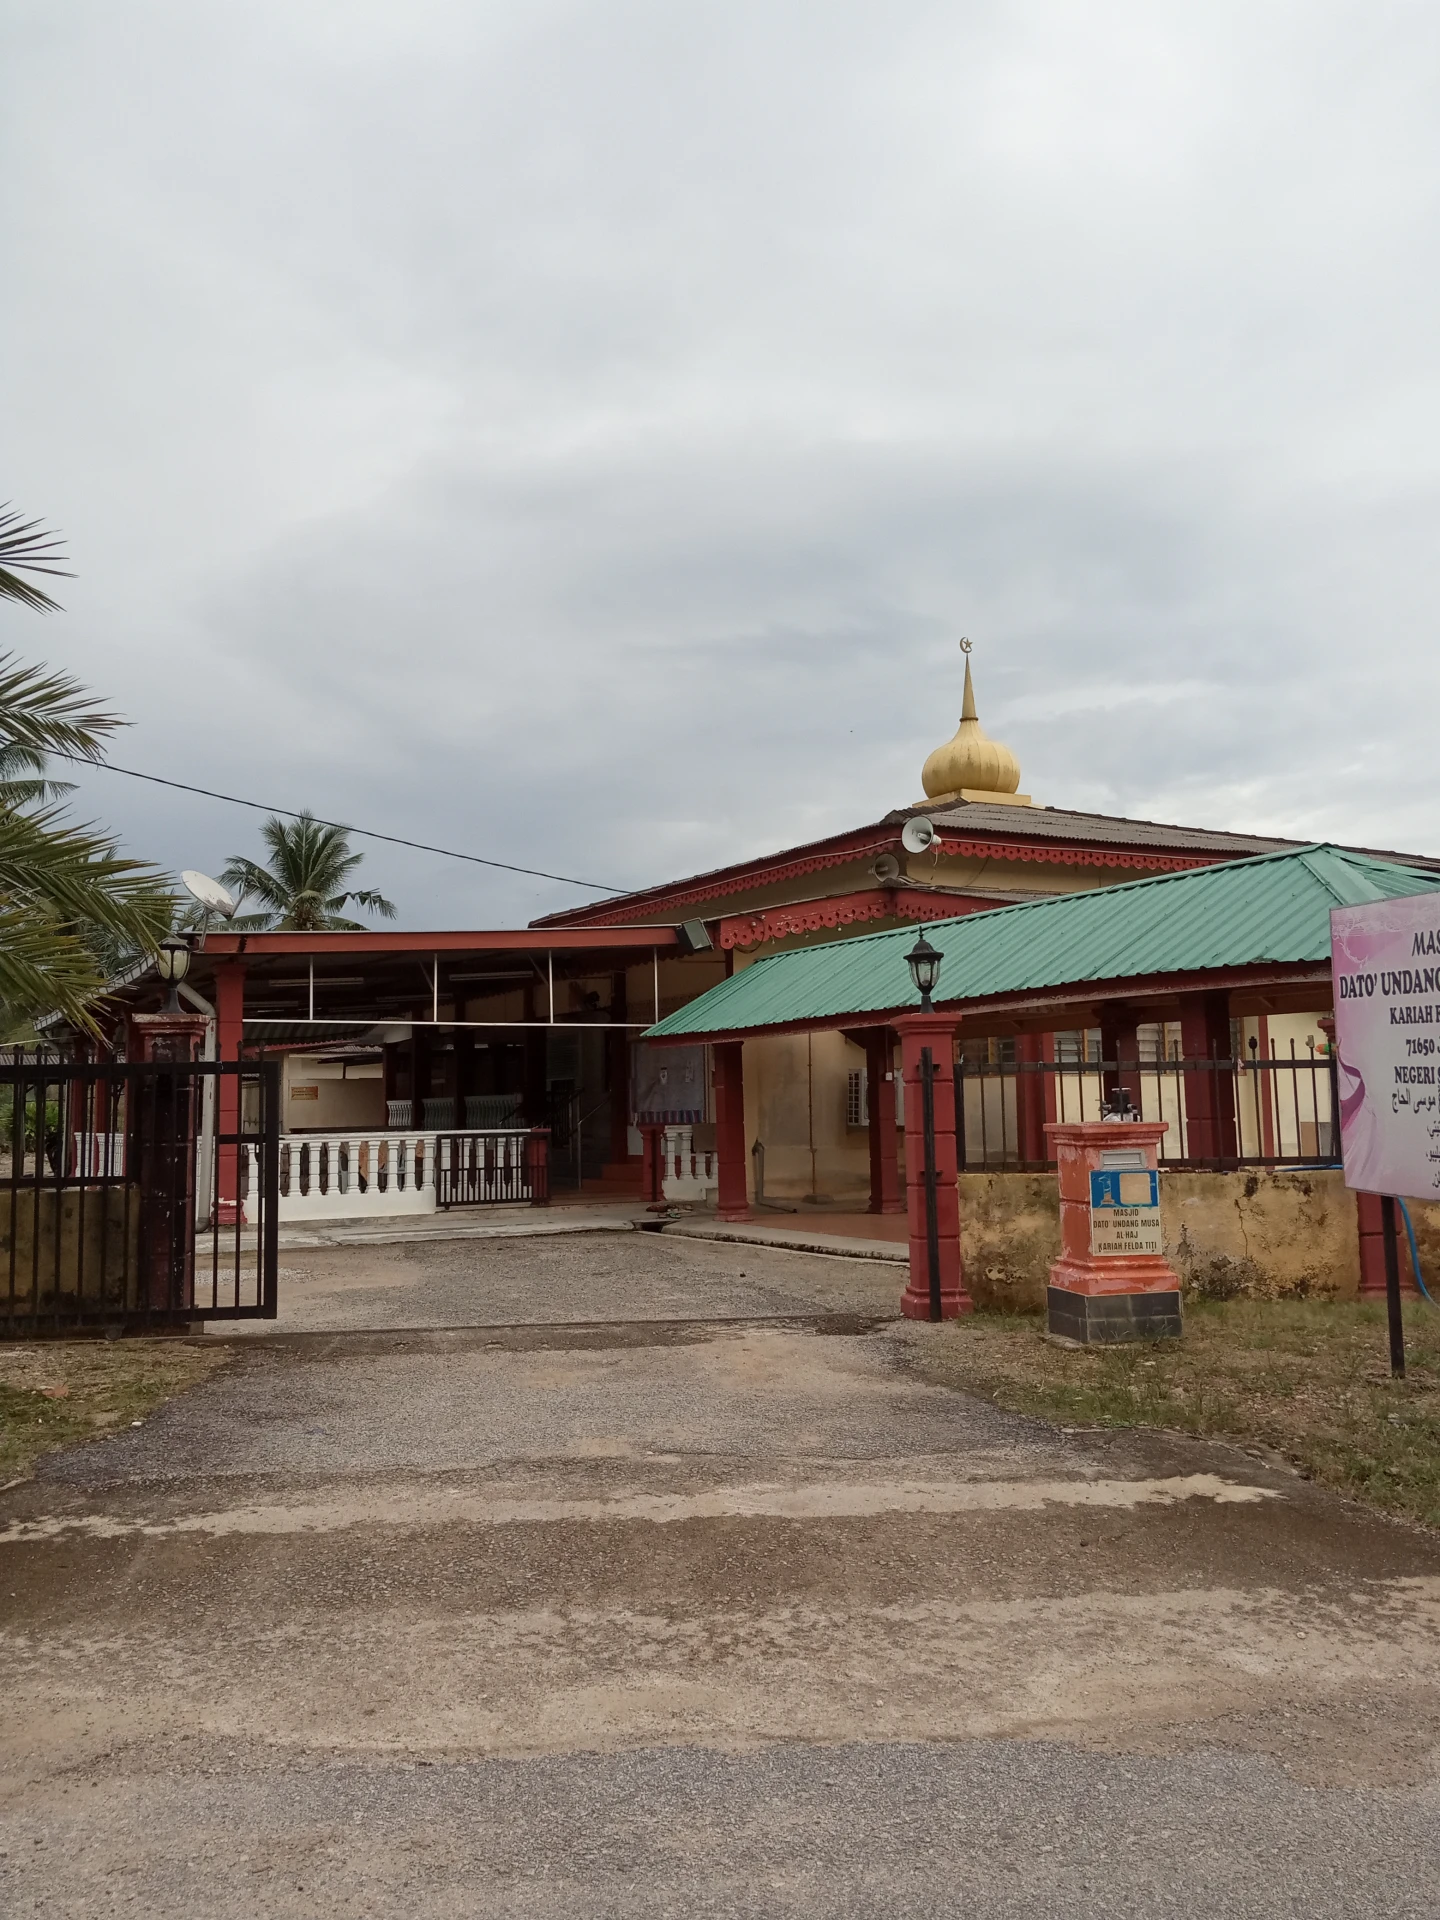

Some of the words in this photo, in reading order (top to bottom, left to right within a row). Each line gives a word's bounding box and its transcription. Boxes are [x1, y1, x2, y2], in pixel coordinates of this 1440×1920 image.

[1339, 972, 1378, 999] DATO'
[1389, 1005, 1433, 1025] KARIAH
[1405, 1037, 1435, 1057] 71650
[1394, 1066, 1436, 1085] NEGERI
[1391, 1087, 1411, 1114] الحاج
[1113, 1208, 1139, 1217] MASJID
[1093, 1220, 1111, 1229] DATO'
[1112, 1220, 1139, 1228] UNDANG
[1140, 1219, 1160, 1228] MUSA
[1098, 1242, 1123, 1251] KARIAH
[1124, 1242, 1144, 1250] FELDA
[1145, 1241, 1157, 1250] TITI
